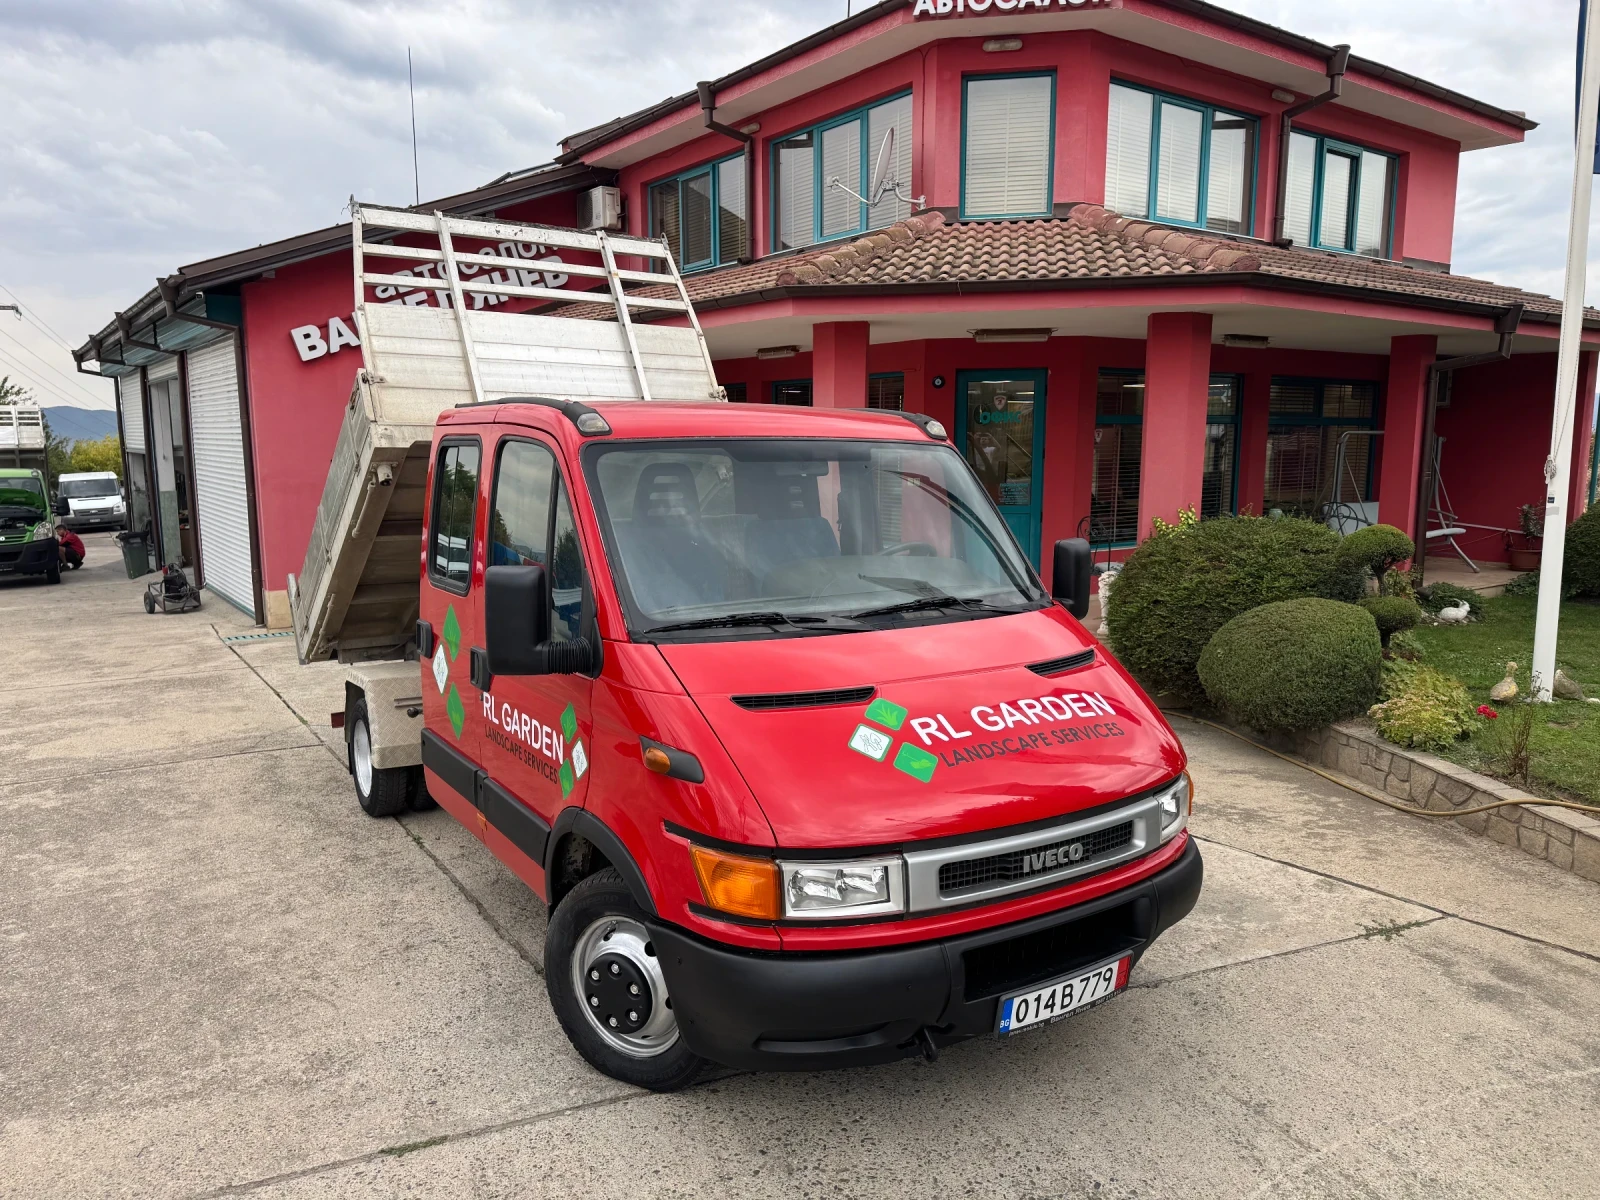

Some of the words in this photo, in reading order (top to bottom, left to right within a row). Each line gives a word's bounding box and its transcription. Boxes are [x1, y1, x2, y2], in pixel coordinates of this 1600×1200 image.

[483, 692, 499, 725] RL
[502, 702, 564, 765] GARDEN
[910, 713, 972, 745] RL
[971, 691, 1117, 732] GARDEN
[485, 723, 522, 761] LANDSCAPE
[524, 749, 558, 785] SERVICES
[940, 732, 1051, 767] LANDSCAPE
[1052, 722, 1125, 744] SERVICES
[1024, 842, 1084, 873] IVECO
[999, 1019, 1011, 1028] BG
